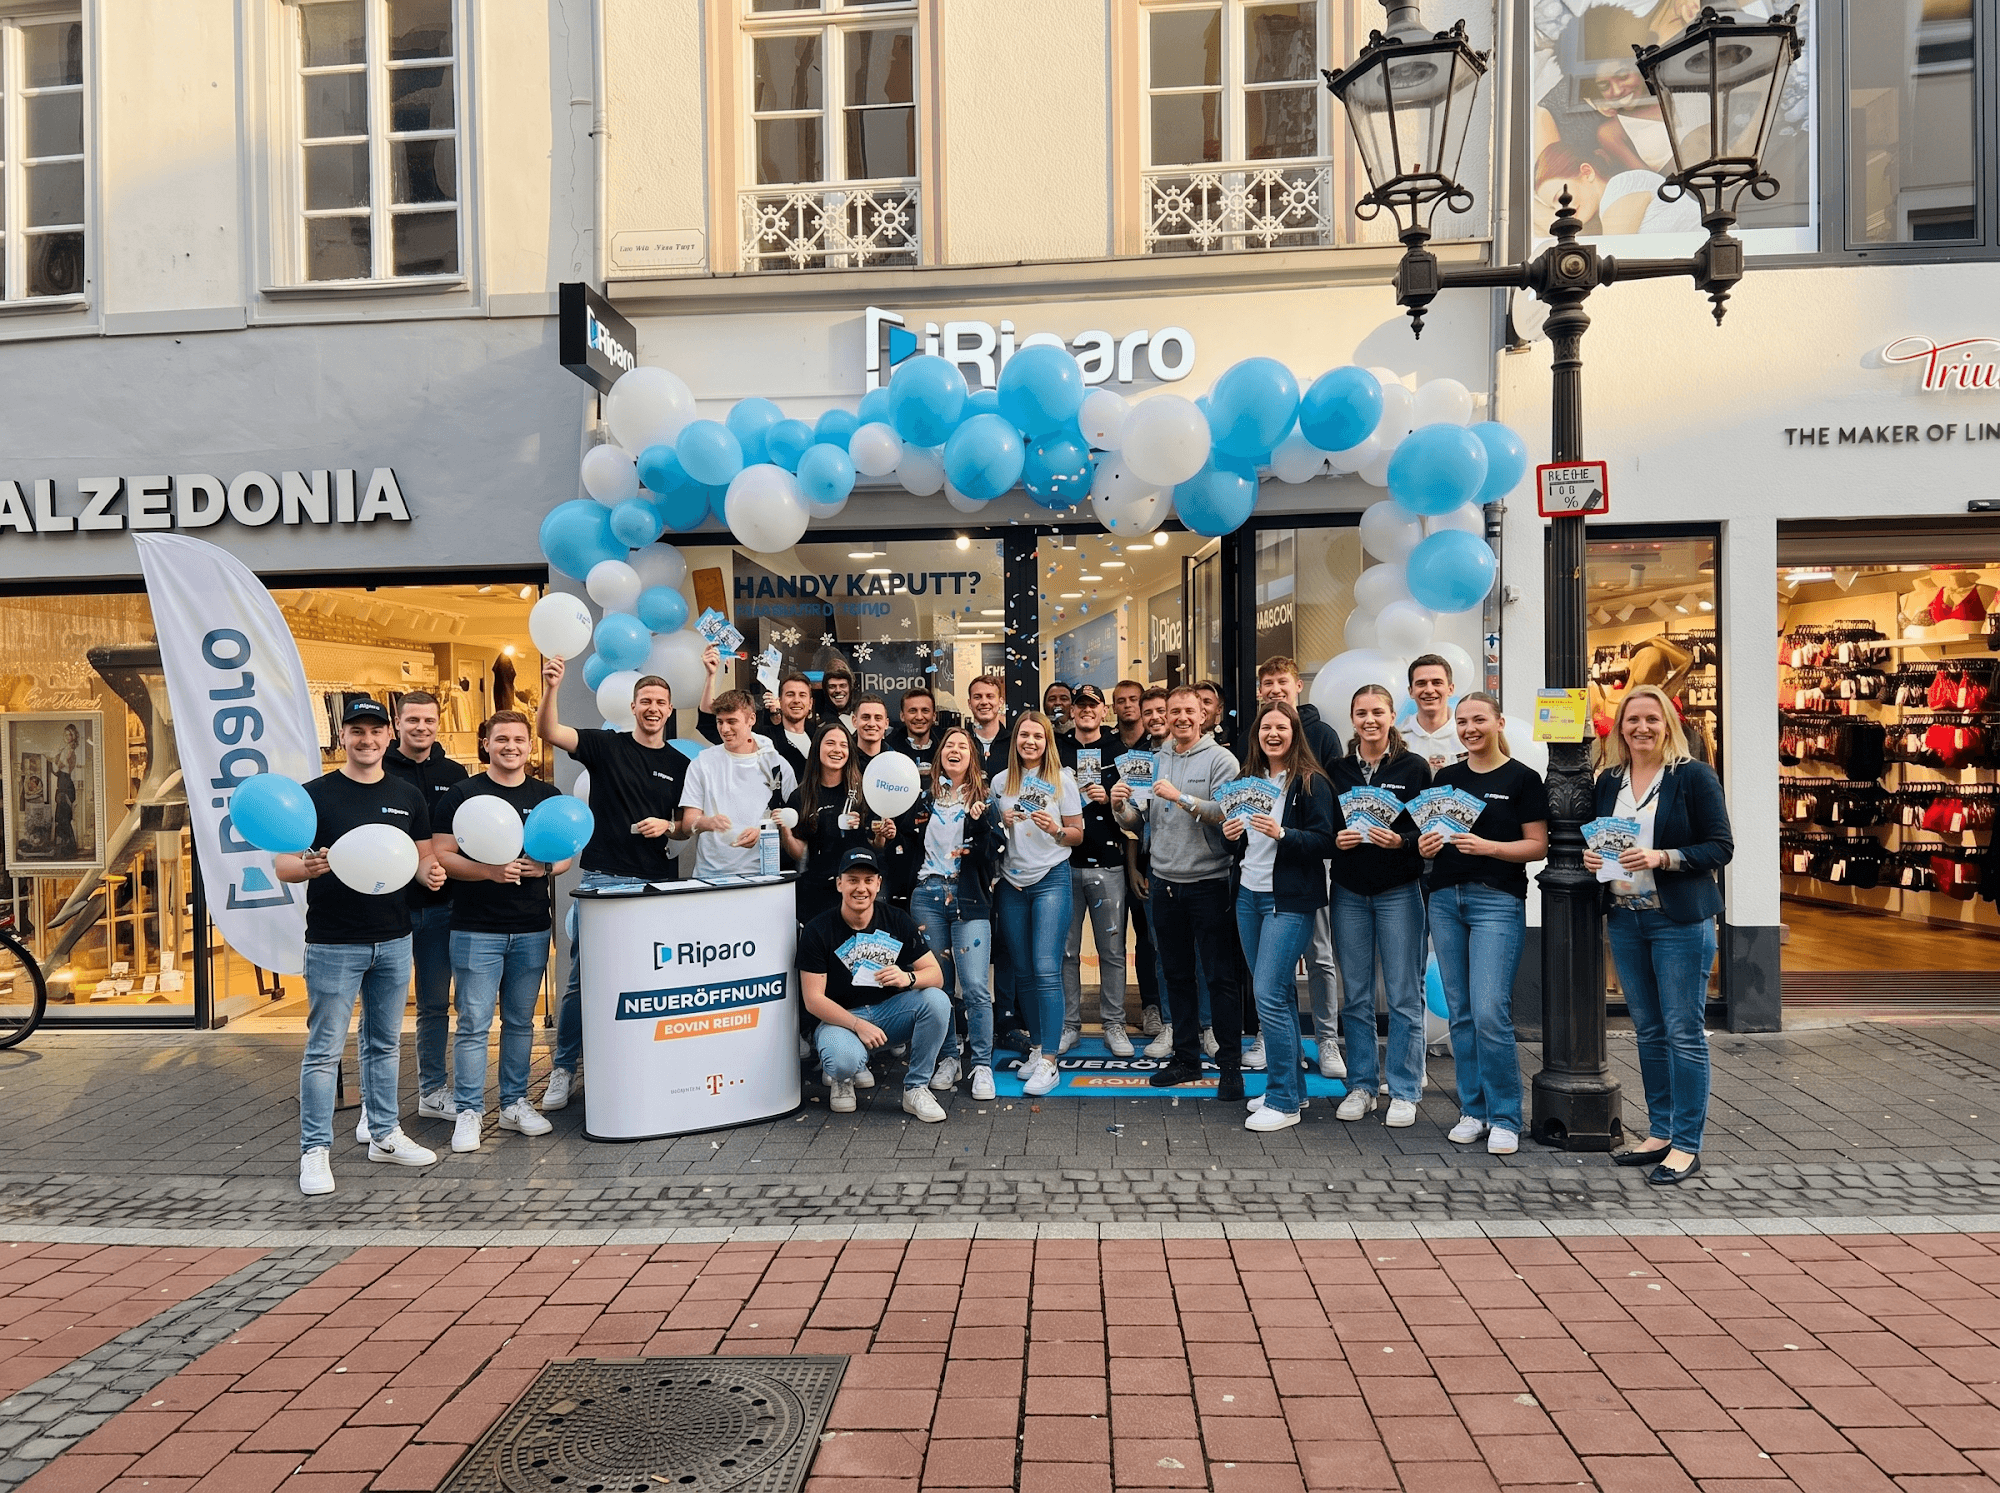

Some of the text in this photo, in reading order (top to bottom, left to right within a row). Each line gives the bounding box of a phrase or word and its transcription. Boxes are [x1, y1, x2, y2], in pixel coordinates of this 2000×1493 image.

[1785, 427, 1830, 445] THE
[1839, 424, 1920, 444] MAKER
[1927, 423, 1958, 442] OF
[733, 571, 982, 599] HANDY KAPUTT?
[865, 673, 926, 694] Riparo
[880, 780, 909, 793] Riparo
[678, 940, 756, 968] Riparo
[625, 979, 782, 1014] NEUERÖFFNUNG
